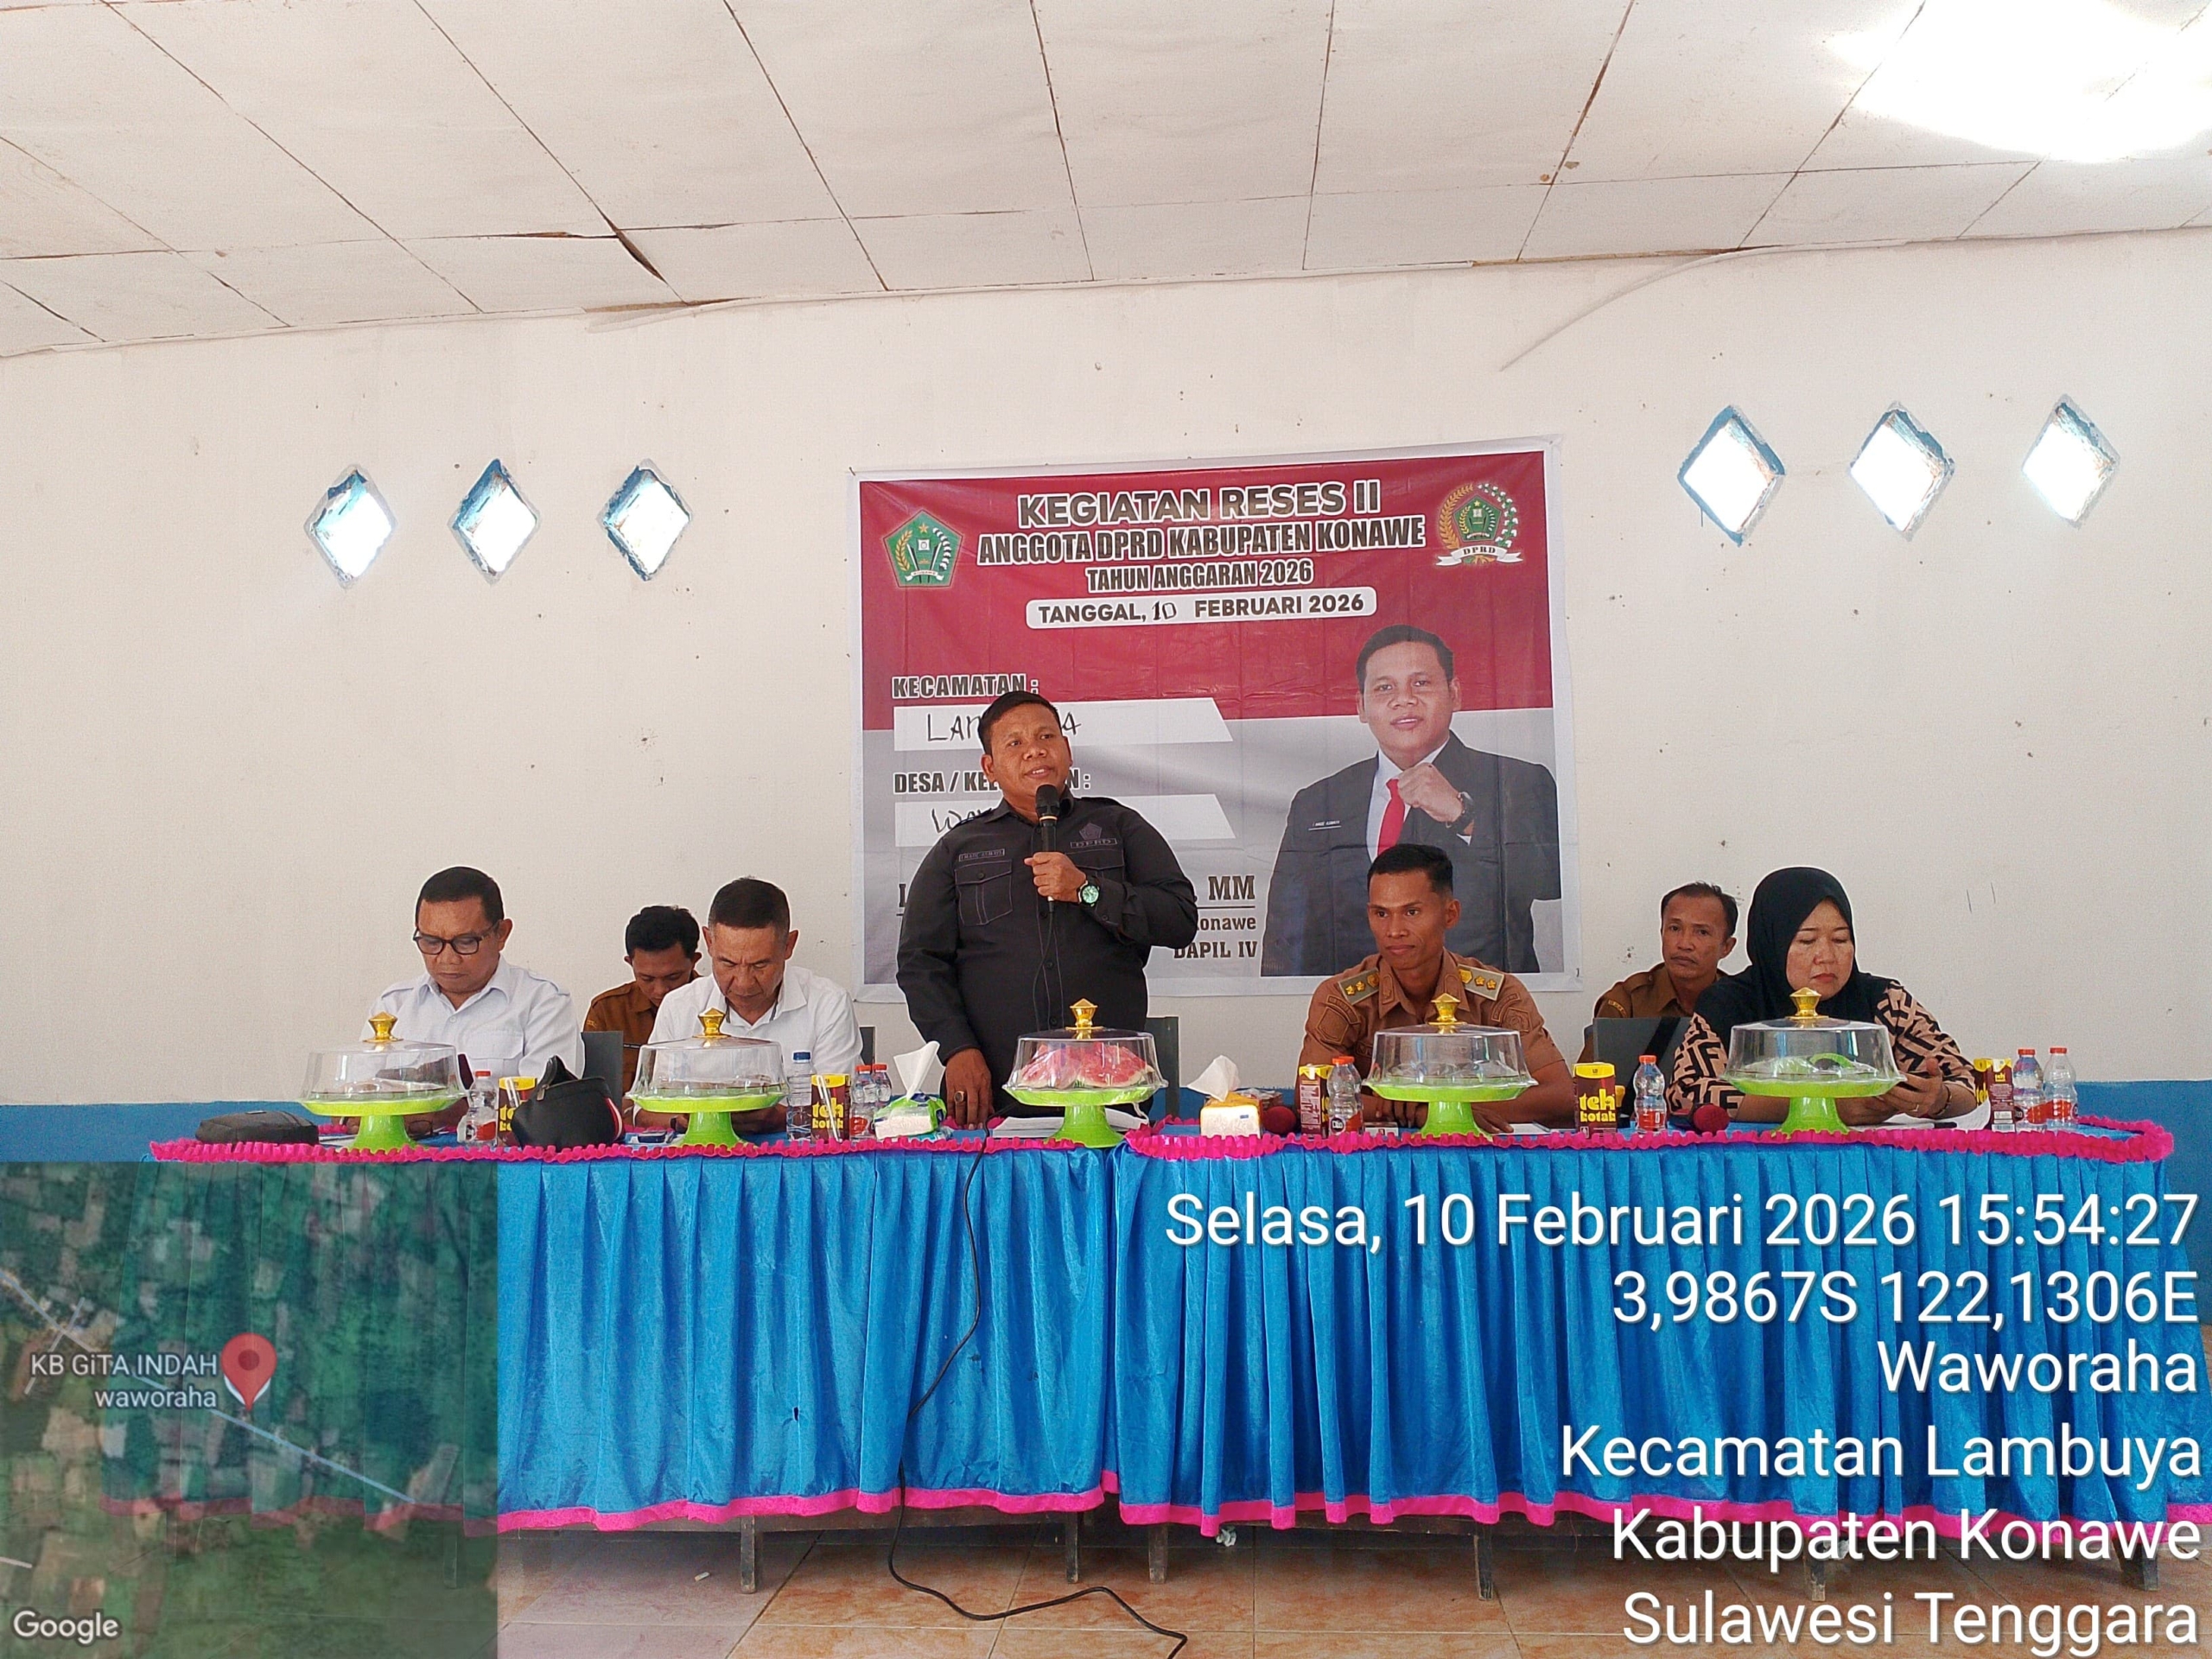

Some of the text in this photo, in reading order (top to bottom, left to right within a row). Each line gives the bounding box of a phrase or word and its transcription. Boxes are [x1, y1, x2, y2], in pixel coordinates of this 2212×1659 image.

[1020, 480, 1381, 527] KEGIATAN RESES II
[978, 516, 1426, 564] ANGGOTA DPRD KABUPATEN KONAWE
[1463, 545, 1496, 555] DPRD
[1086, 559, 1313, 593] TAHUN ANGGARAN 2026
[1038, 603, 1147, 624] TANGGAL,
[1195, 596, 1302, 618] FEBRUARI
[1308, 593, 1364, 613] 2026
[893, 675, 1026, 698] KECAMATAN
[894, 772, 945, 793] DESA
[1208, 875, 1255, 900] MM
[1198, 917, 1256, 931] onawe
[1238, 941, 1258, 958] IV
[1579, 1088, 1616, 1111] teh
[1580, 1111, 1617, 1123] kotak
